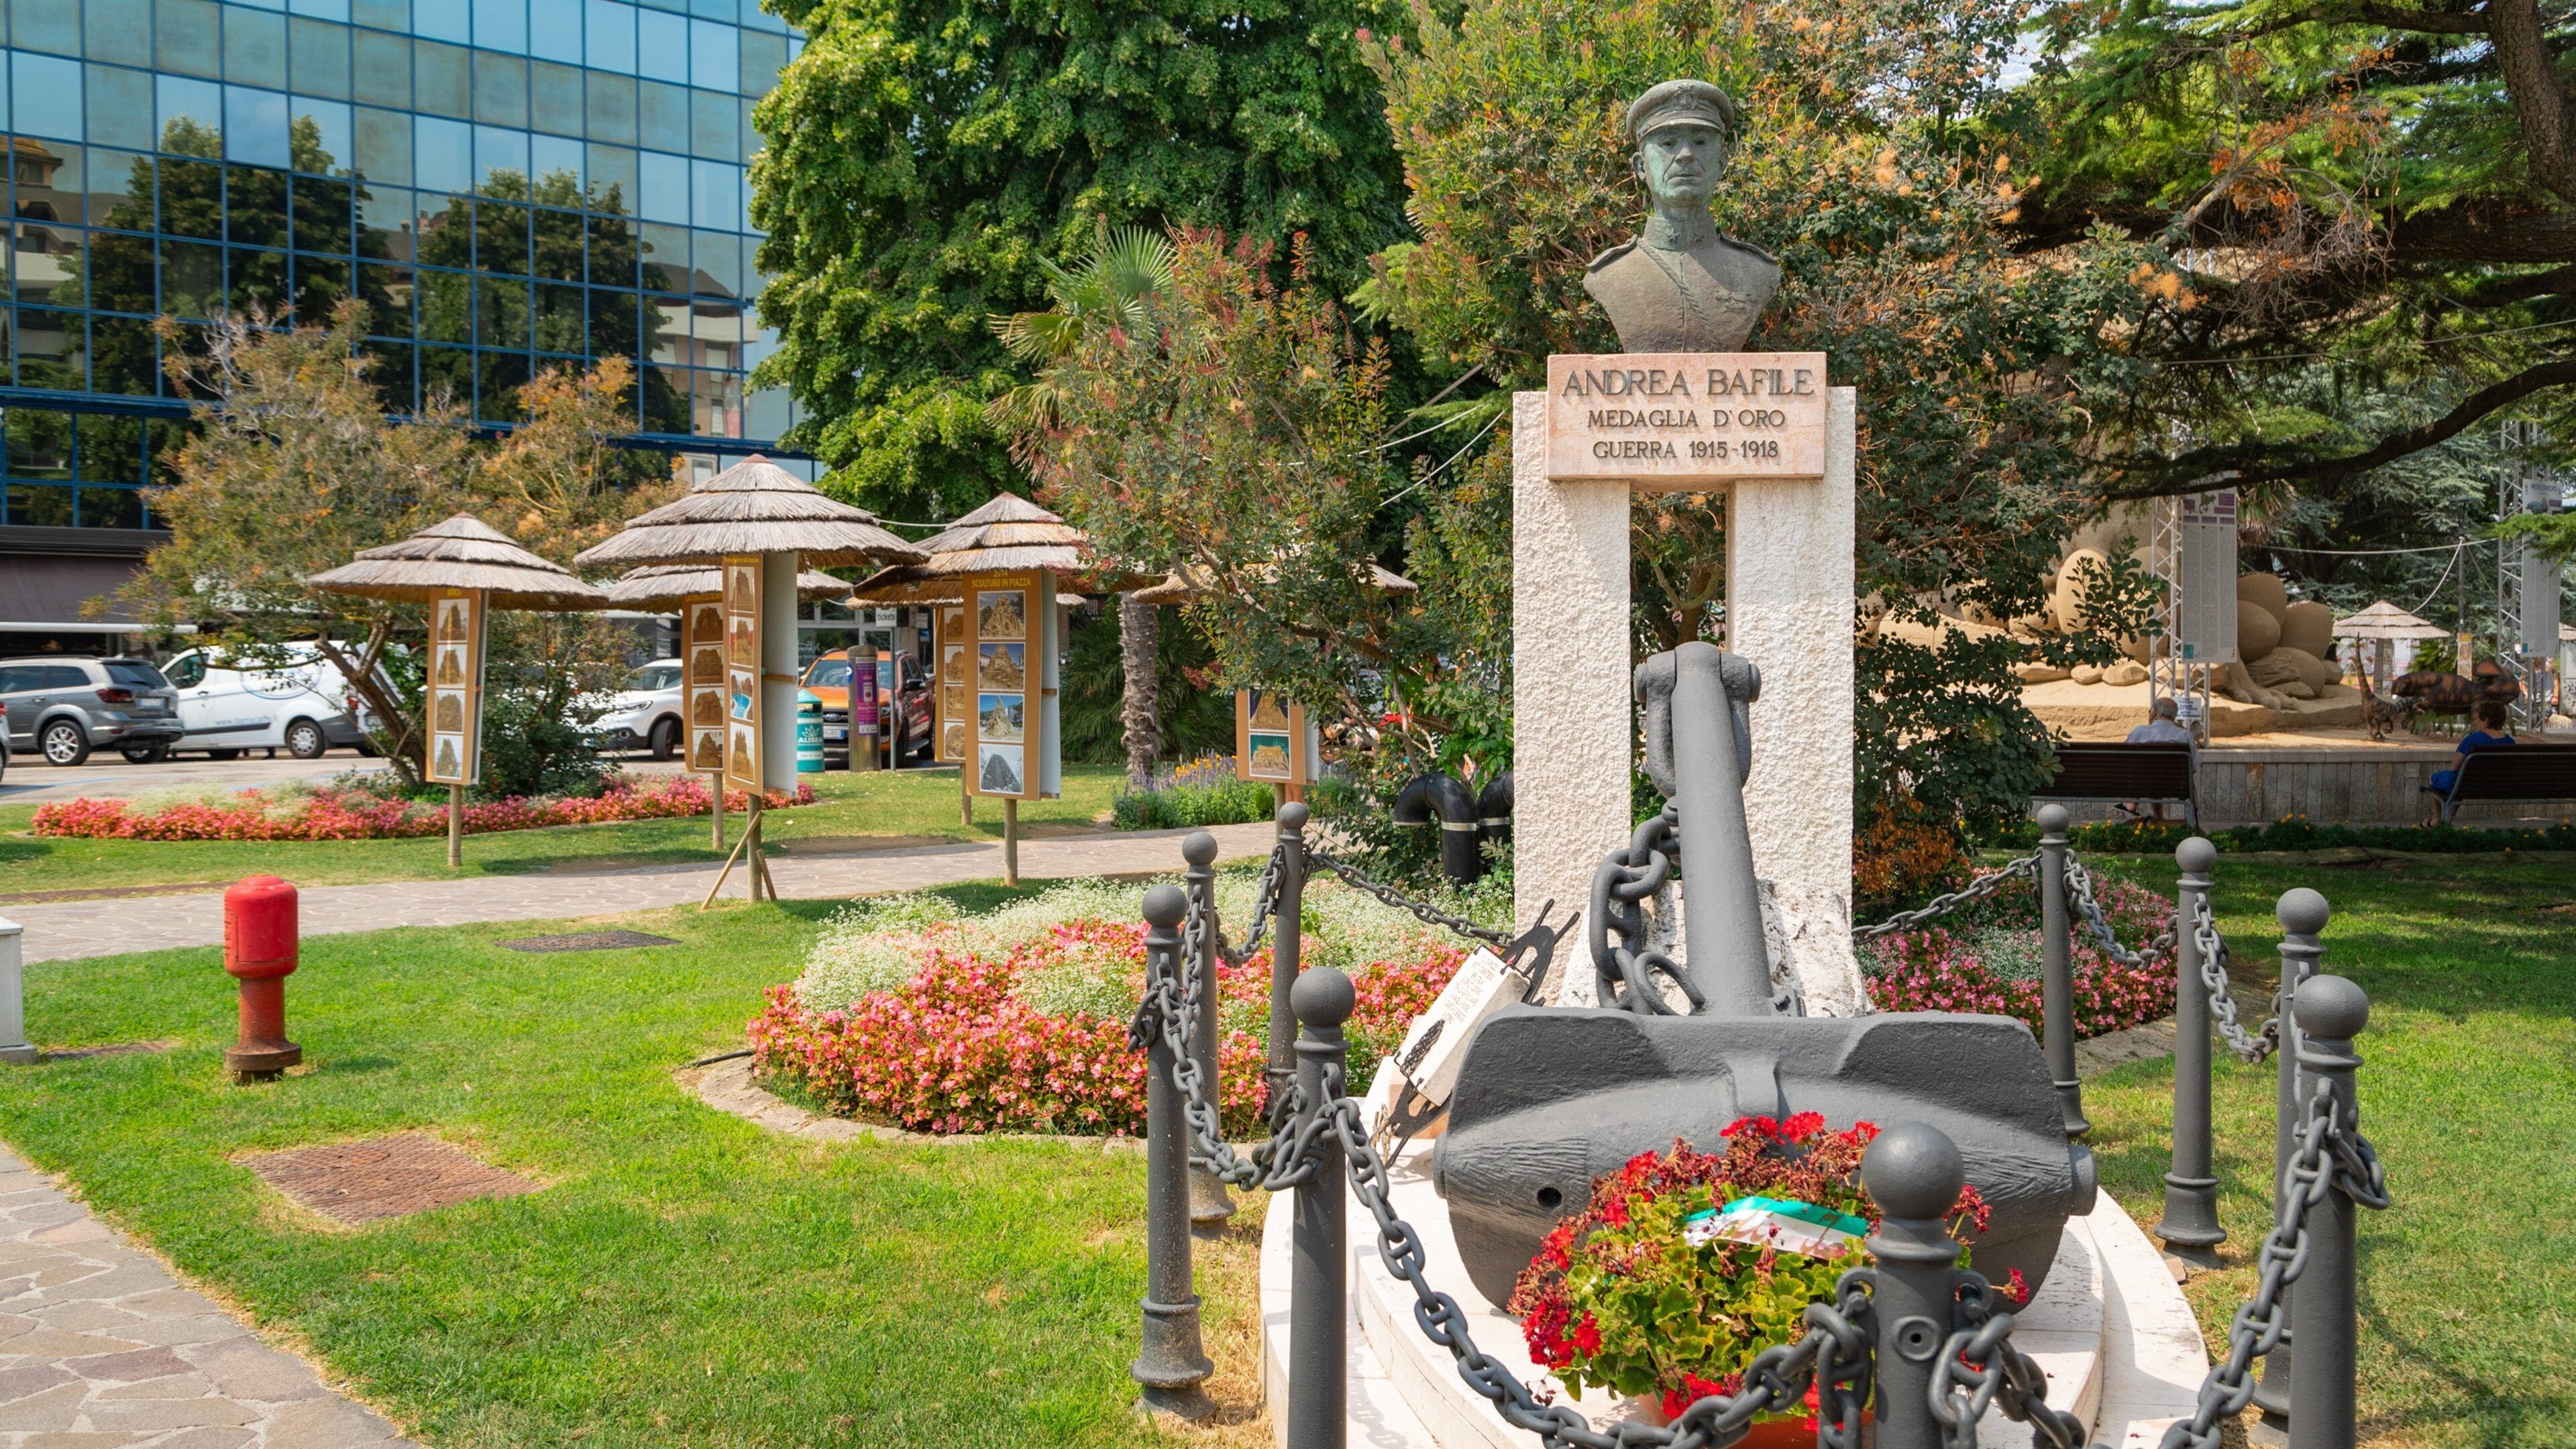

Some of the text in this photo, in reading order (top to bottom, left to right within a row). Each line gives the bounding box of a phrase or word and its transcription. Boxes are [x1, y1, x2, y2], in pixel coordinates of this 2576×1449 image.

[1562, 368, 1813, 396] ANDREA BAFILE
[1587, 410, 1699, 428] MEDAGLIA
[1593, 441, 1677, 458] GUERRA
[971, 578, 1031, 588] SCULTURE IN PIAZZA
[877, 612, 896, 621] tickets
